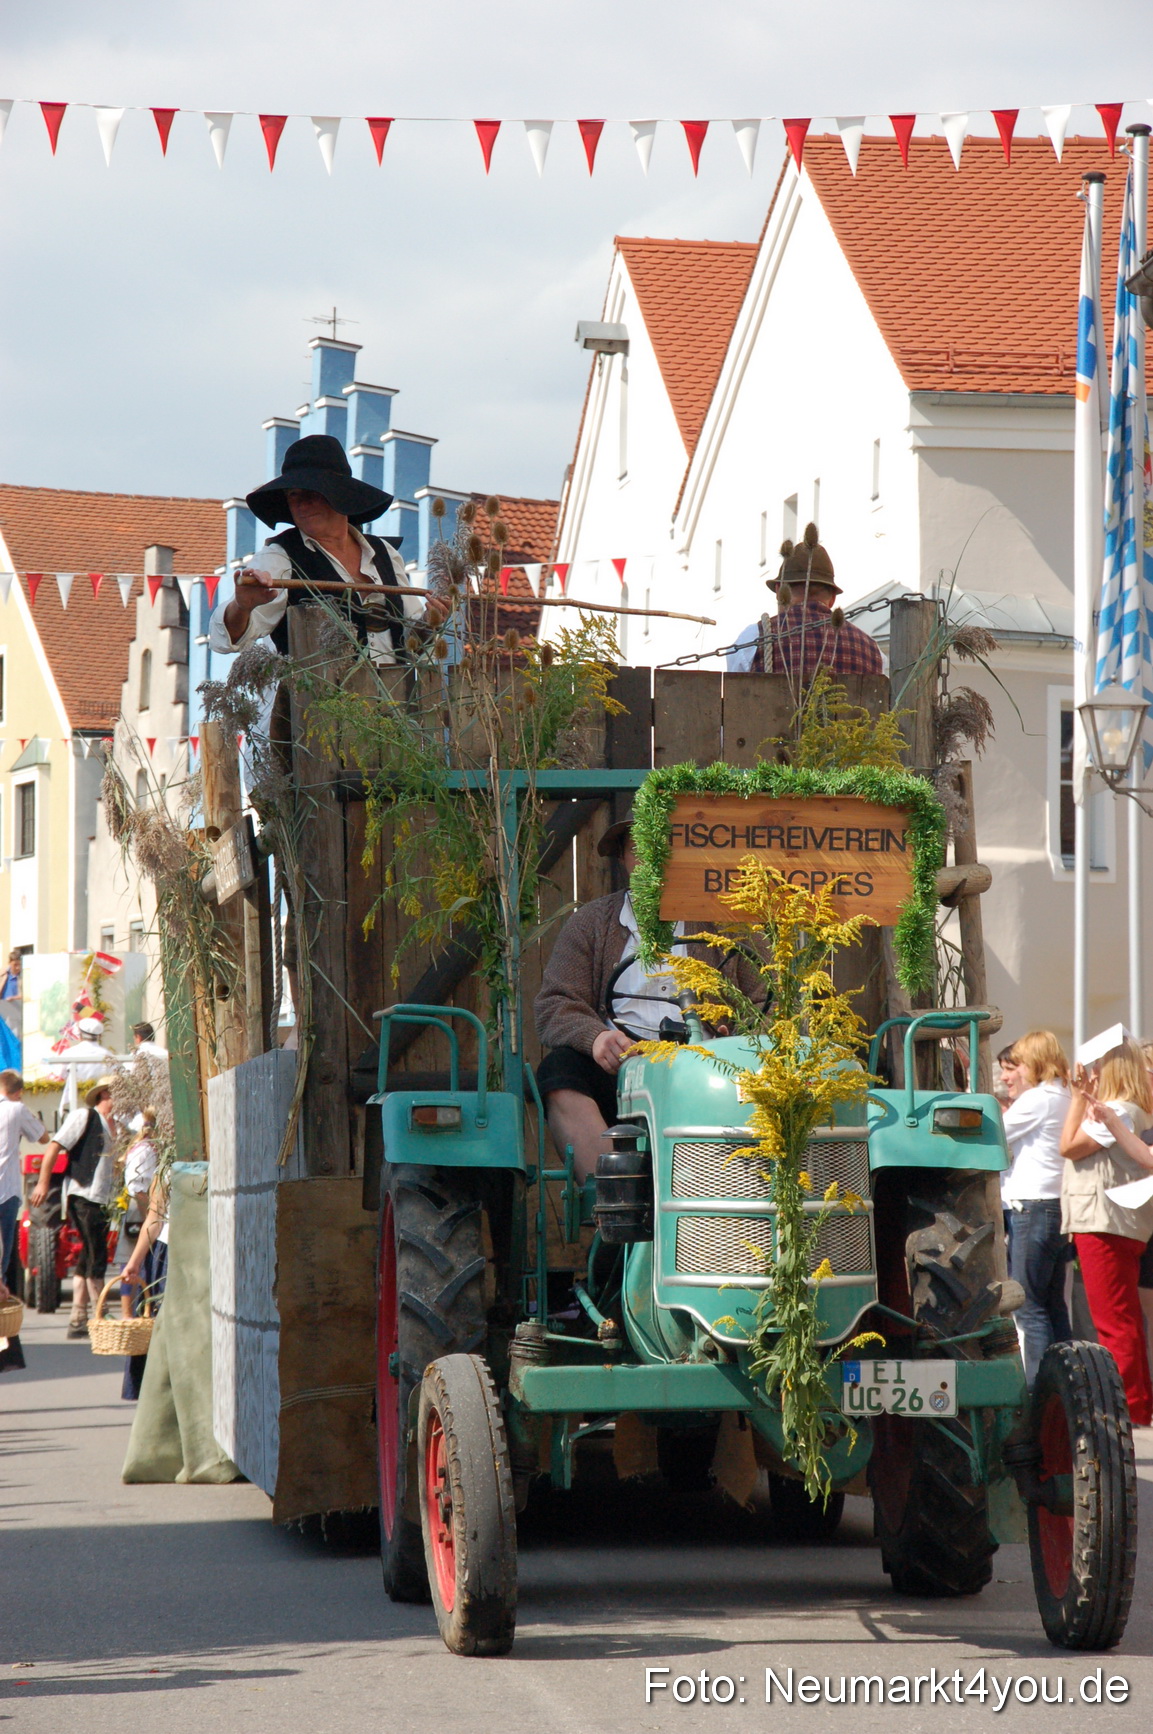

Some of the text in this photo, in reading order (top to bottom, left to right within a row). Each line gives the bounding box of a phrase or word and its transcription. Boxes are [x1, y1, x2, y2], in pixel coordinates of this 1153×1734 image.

[669, 823, 908, 851] FISCHEREIVEREIN
[704, 869, 874, 897] BENGRIES
[849, 1373, 856, 1381] D
[873, 1361, 906, 1384] EI
[849, 1386, 924, 1412] UC 26
